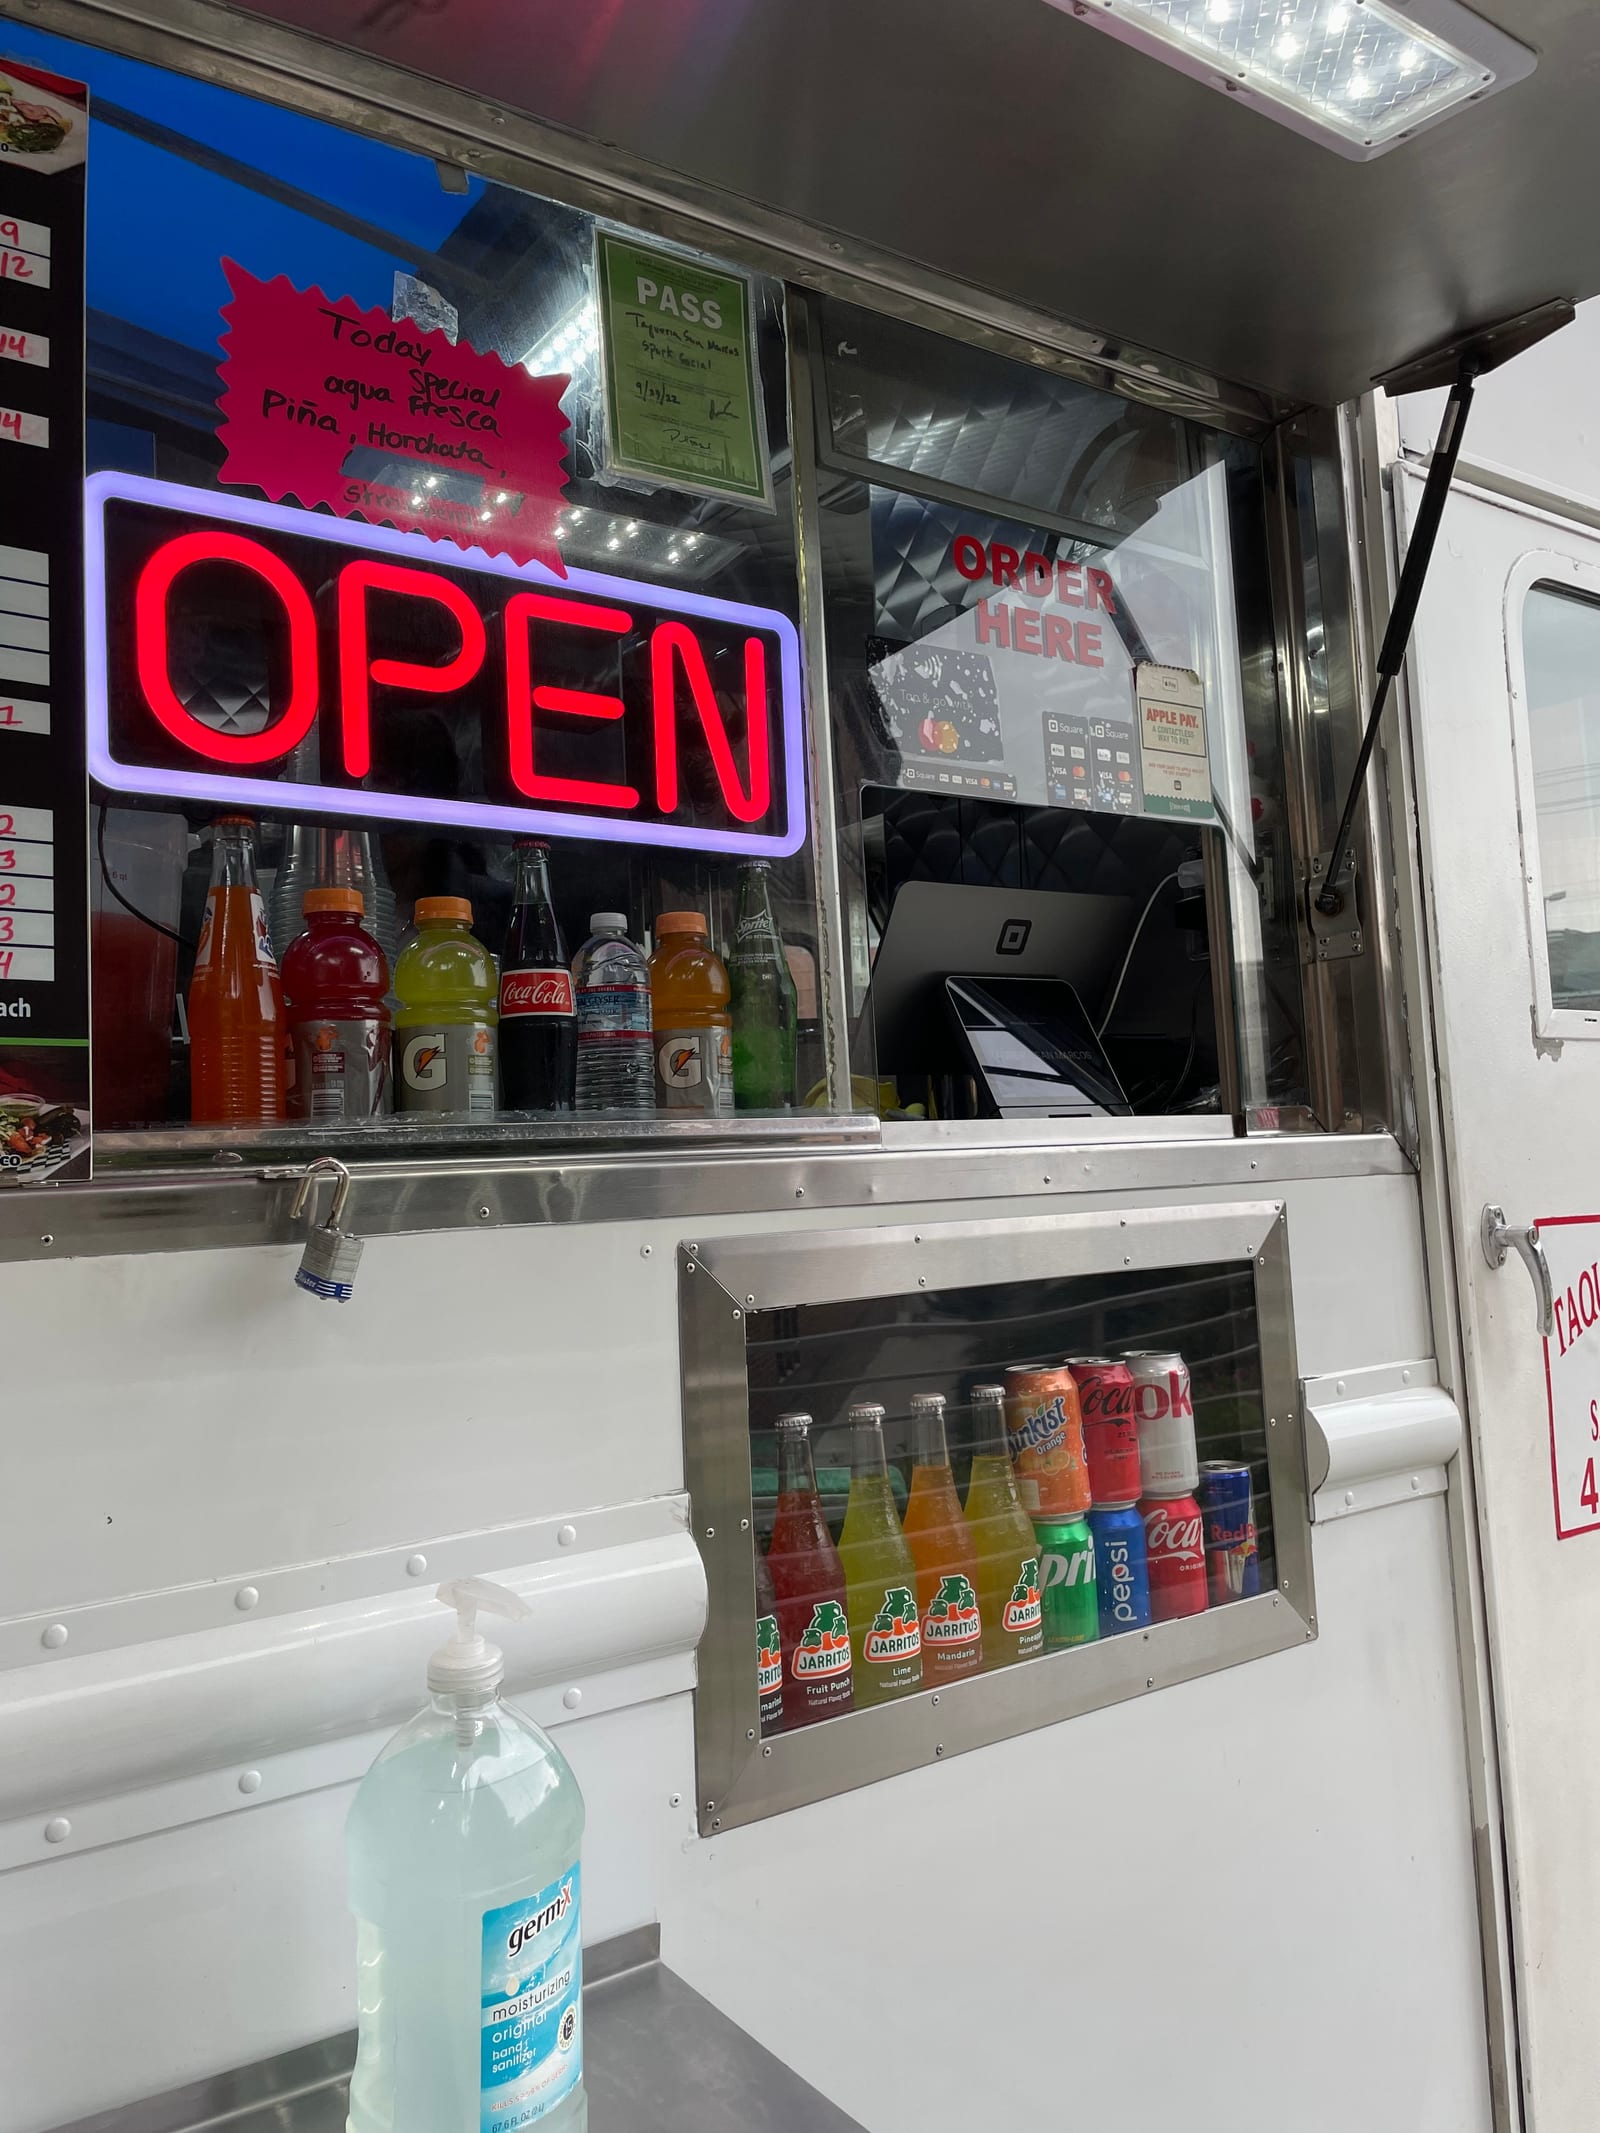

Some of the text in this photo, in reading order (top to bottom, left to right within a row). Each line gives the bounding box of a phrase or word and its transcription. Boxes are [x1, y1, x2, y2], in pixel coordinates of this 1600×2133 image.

[637, 276, 722, 329] PASS
[318, 307, 432, 367] Today
[953, 534, 1117, 614] ORDER
[976, 598, 1104, 668] HERE
[136, 531, 771, 823] OPEN
[1146, 707, 1178, 726] APPLE
[1058, 722, 1084, 735] Square
[1105, 728, 1129, 740] Square
[916, 769, 936, 781] Square
[965, 776, 979, 786] VISA
[1052, 766, 1068, 776] VISA
[1099, 770, 1114, 780] VISA
[738, 918, 769, 934] Sprite
[503, 980, 566, 1006] Coca-Cola
[402, 1033, 448, 1092] G
[658, 1036, 703, 1089] G
[1590, 1399, 1600, 1442] S
[1037, 1431, 1067, 1455] Orange
[1038, 1535, 1096, 1597] pri
[1104, 1541, 1138, 1621] pepsi
[926, 1618, 977, 1637] JARRITOS
[871, 1632, 919, 1653] JARRITOS
[937, 1647, 976, 1661] Mandarin
[799, 1647, 850, 1670] JARRITOS
[893, 1666, 911, 1676] Lime
[806, 1677, 850, 1695] Fruit Punch
[493, 1970, 571, 2021] moisturizing
[492, 2012, 547, 2044] original
[492, 2040, 523, 2061] hand
[492, 2048, 537, 2073] sanitizer
